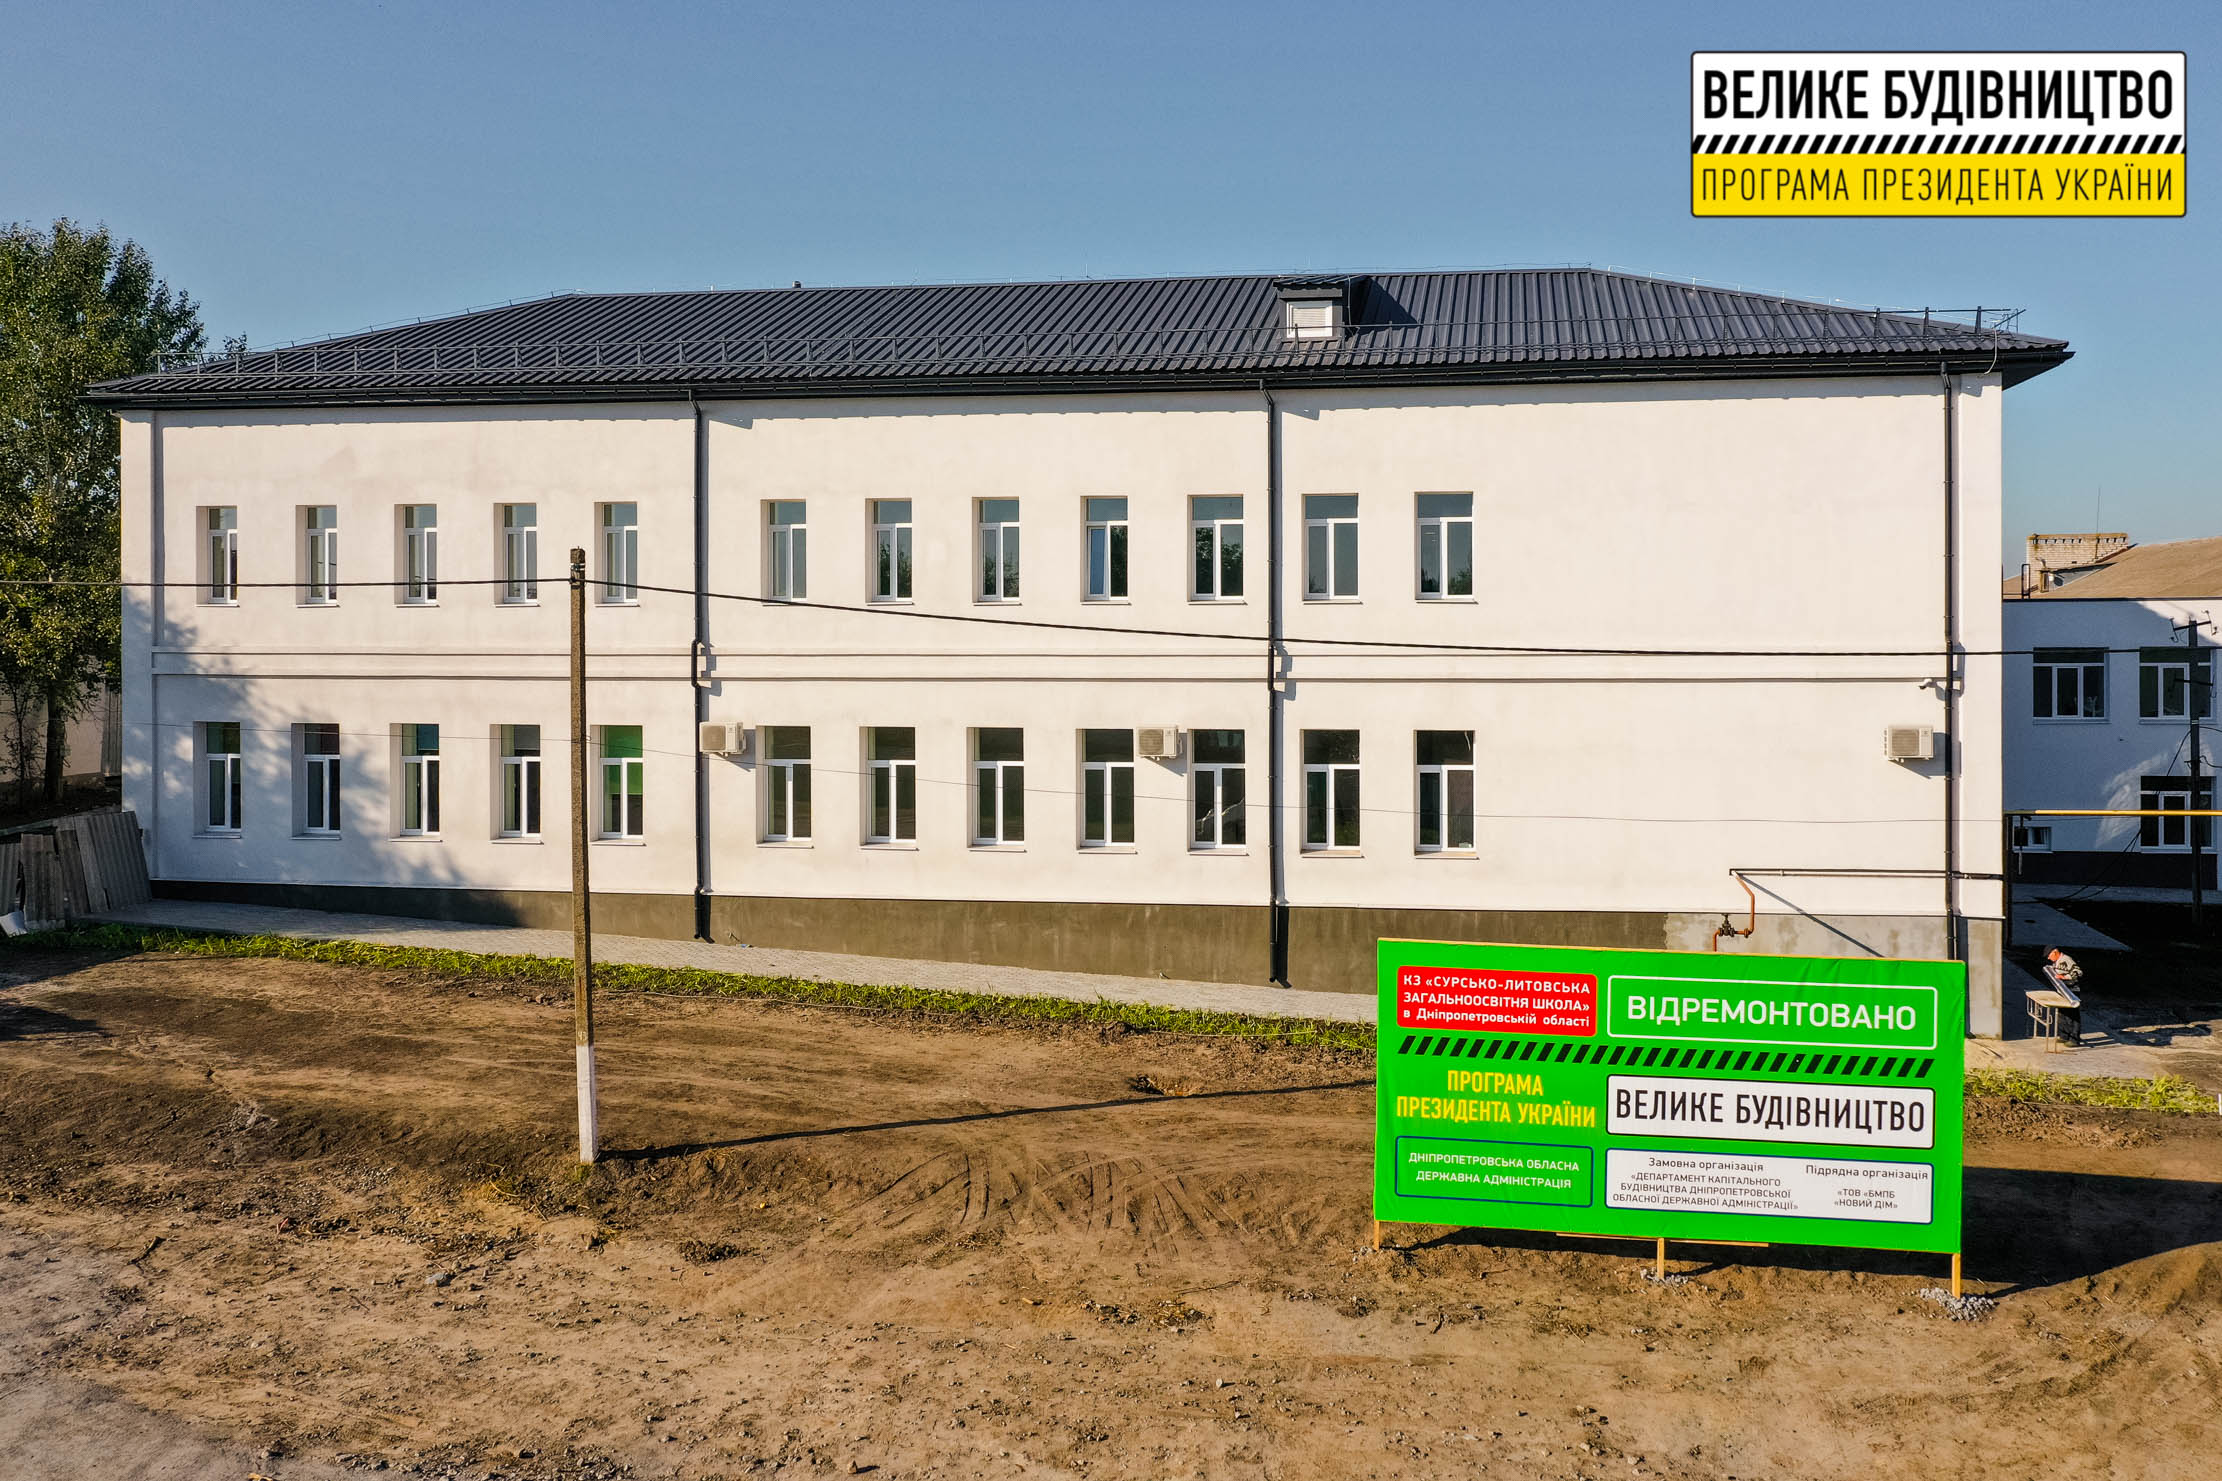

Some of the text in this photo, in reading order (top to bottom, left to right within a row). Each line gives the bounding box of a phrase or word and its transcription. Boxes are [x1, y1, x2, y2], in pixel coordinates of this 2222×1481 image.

[1403, 975, 1590, 994] КЗ «СУРСЬКО-ЛИТОВСЬКА
[1403, 992, 1590, 1011] ЗАГАЛЬНООСВІТНЯ ШКОЛА»
[1403, 1008, 1590, 1027] в Дніпропетровській області
[1627, 995, 1917, 1031] ВІДРЕМОНТОВАНО
[1447, 1070, 1543, 1096] ПРОГРАМА
[1396, 1096, 1596, 1128] ПРЕЗИДЕНТА УКРАЇНИ
[1615, 1088, 1926, 1134] ВЕЛИКЕ БУДІВНИЦТВО
[1408, 1152, 1580, 1171] ДНІПРОПЕТРОВСЬКА ОБЛАСНА
[1648, 1157, 1764, 1172] Замовна організація
[1415, 1171, 1572, 1189] ДЕРЖАВНА АДМІНІСТРАЦІЯ
[1631, 1172, 1781, 1187] «ДЕПАРТАМЕНТ КАПІТАЛЬНОГО
[1805, 1165, 1928, 1180] Підрядна організація
[1620, 1183, 1791, 1198] БУДІВНИЦТВА ДНІПРОПЕТРОВСЬКОЇ
[1612, 1193, 1799, 1210] ОБЛАСНОЇ ДЕРЖАВНОЇ АДМІНІСТРАЦІЇ»
